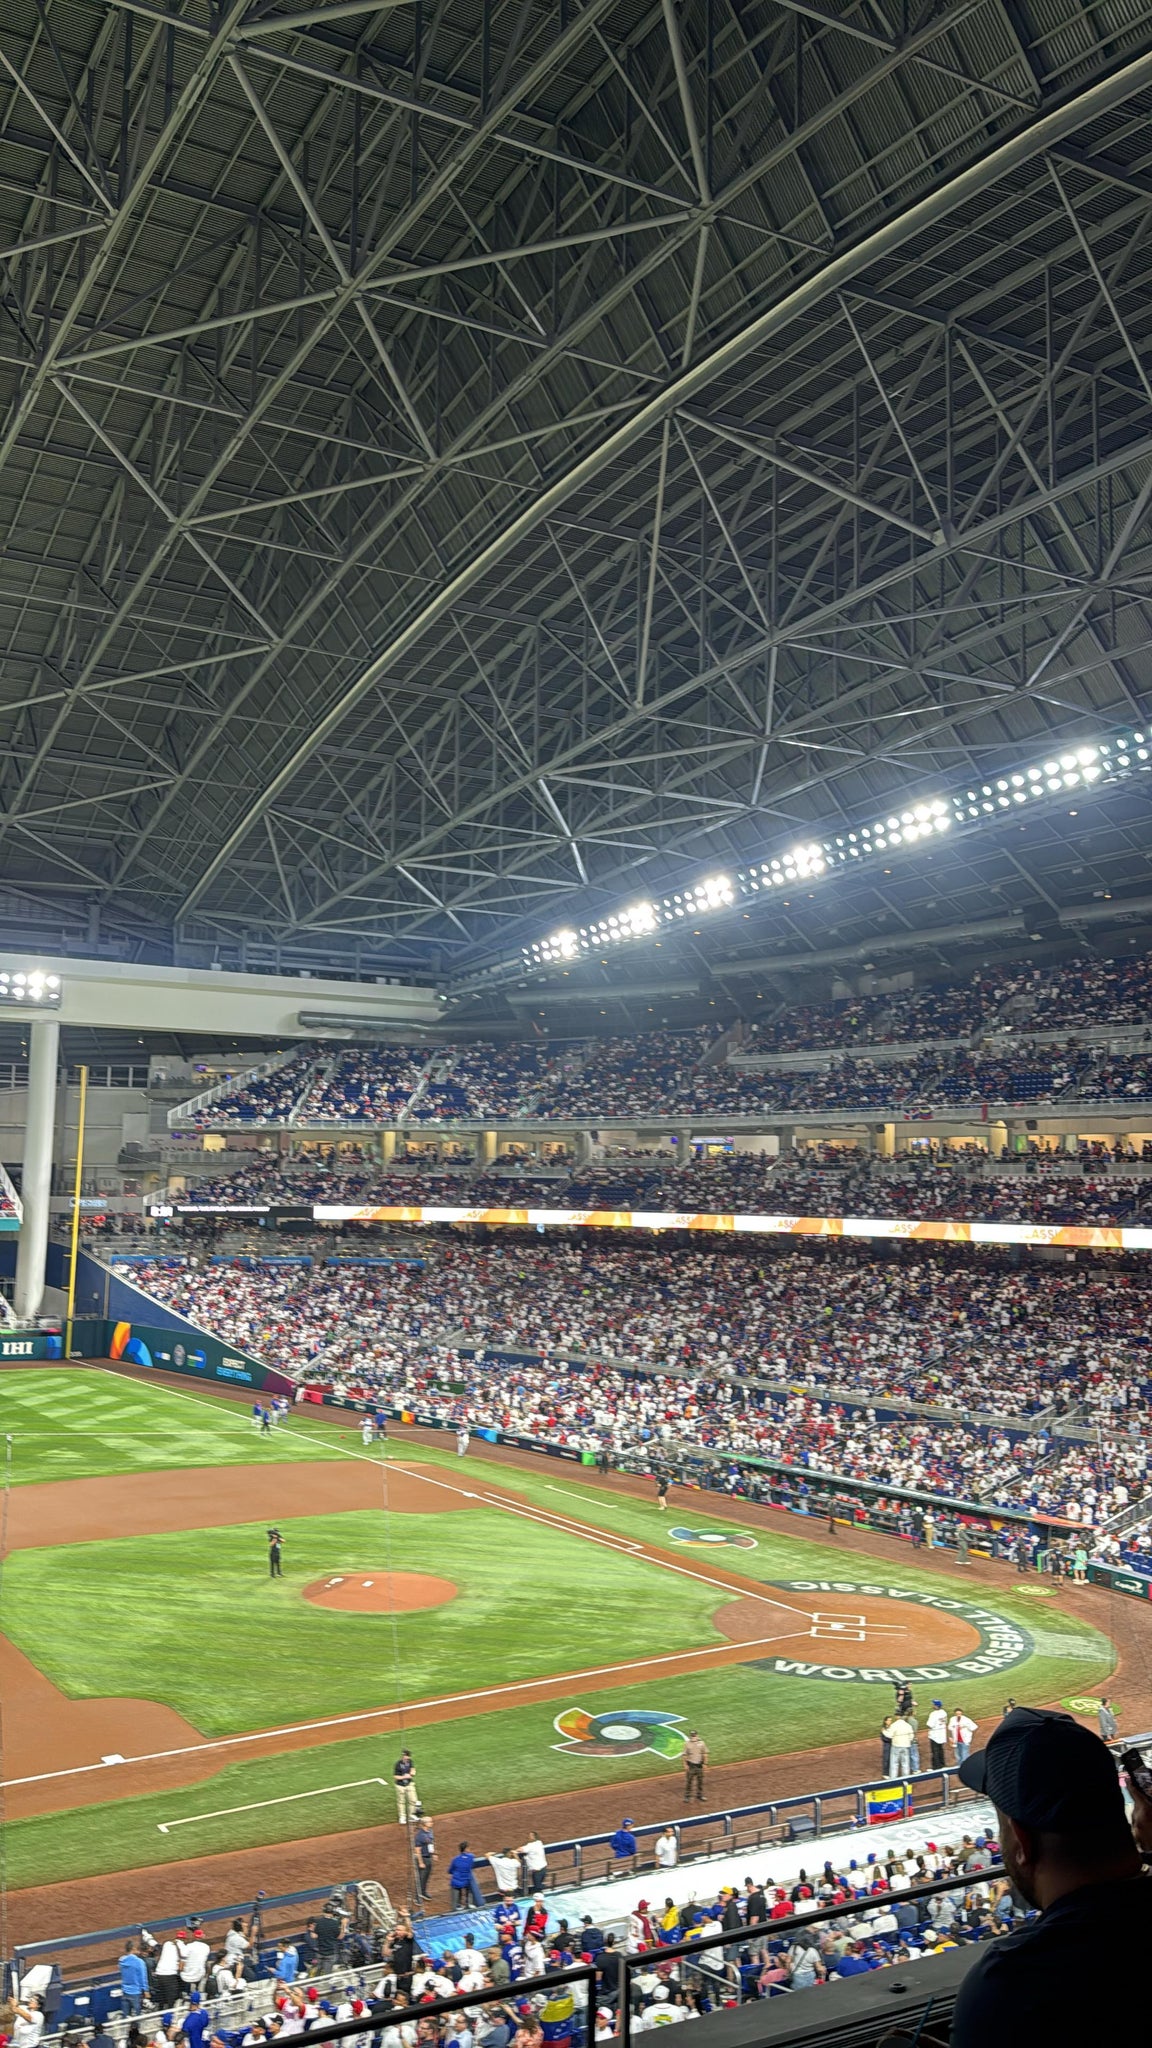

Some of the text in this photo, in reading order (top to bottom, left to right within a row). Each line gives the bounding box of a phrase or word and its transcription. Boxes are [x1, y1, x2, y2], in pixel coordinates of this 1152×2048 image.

[1, 1341, 34, 1355] IHI
[773, 1581, 1025, 1682] WORLD BASEBALL CLASSIC
